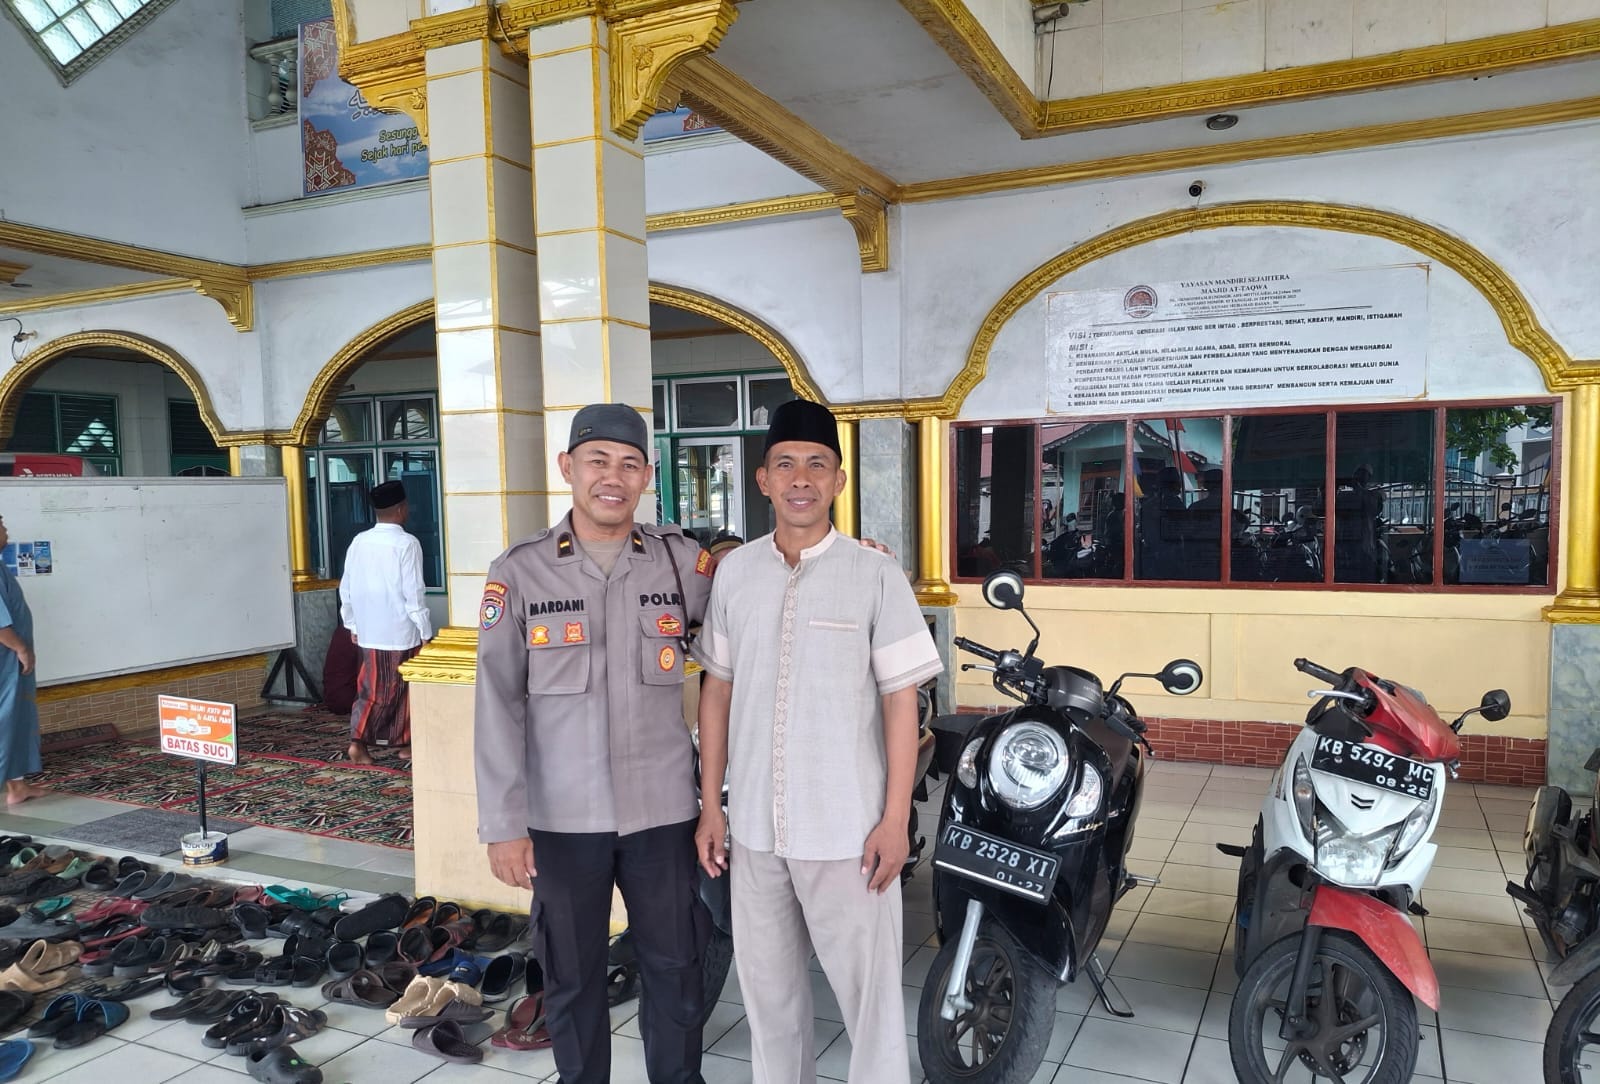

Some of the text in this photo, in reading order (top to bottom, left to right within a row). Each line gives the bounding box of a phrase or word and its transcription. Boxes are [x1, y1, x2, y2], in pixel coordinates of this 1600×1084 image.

[379, 127, 418, 142] Sesungg
[361, 145, 388, 163] Sejak
[390, 139, 409, 157] hari
[1248, 274, 1290, 283] SEJAHTERA
[1241, 320, 1283, 328] BERPRESTASI,
[529, 599, 584, 616] MARDANI
[640, 593, 682, 607] POLR
[167, 738, 228, 758] BATAS SUCI
[1318, 737, 1434, 782] KB 5494 MC
[948, 830, 1048, 878] KB 2528 XI
